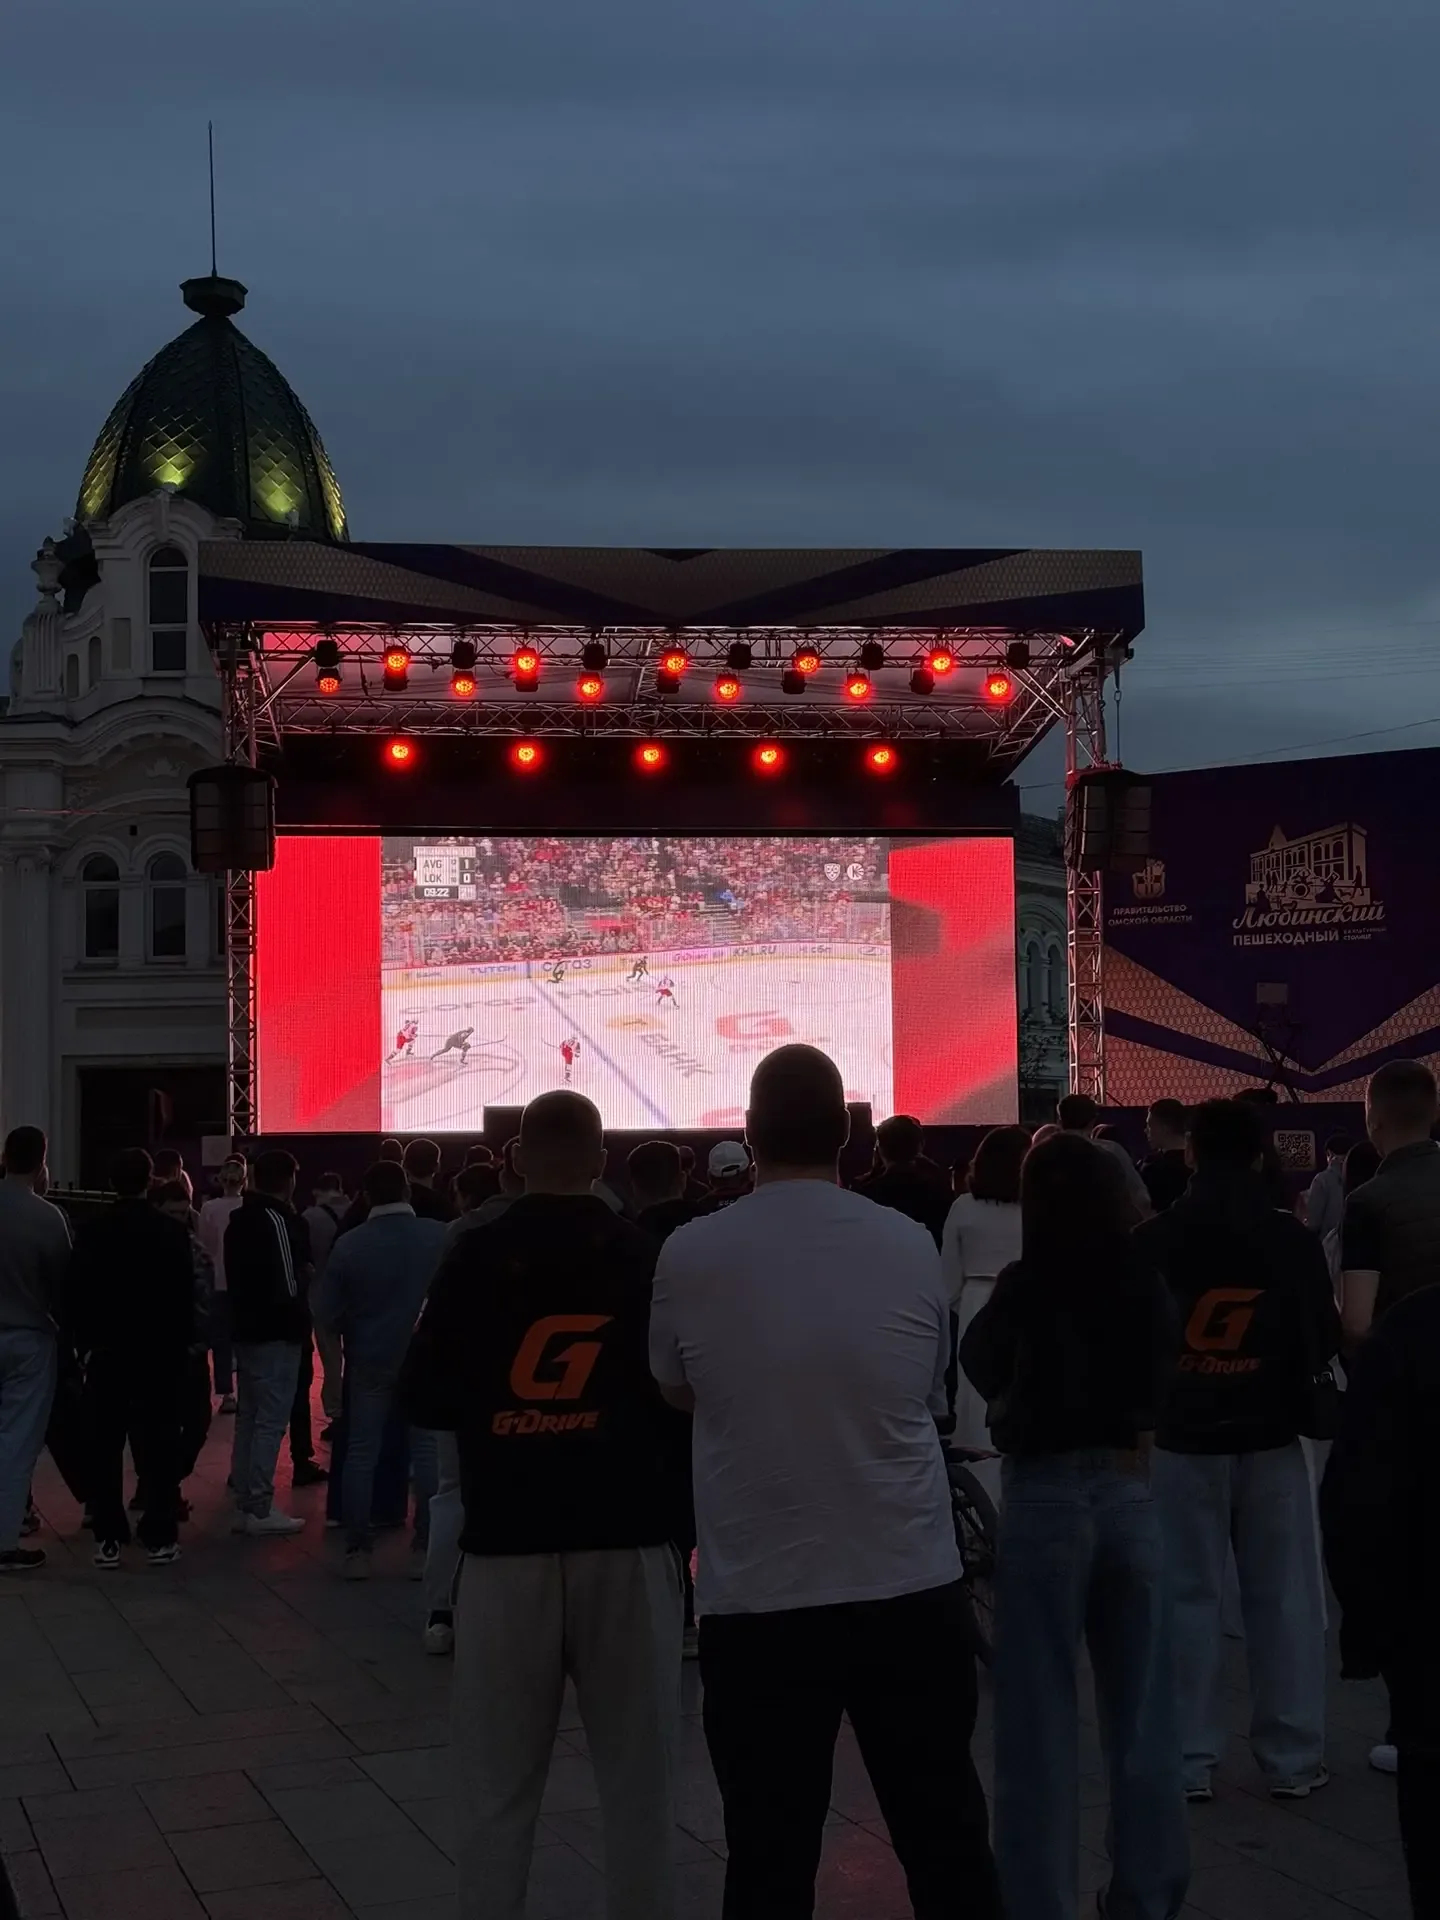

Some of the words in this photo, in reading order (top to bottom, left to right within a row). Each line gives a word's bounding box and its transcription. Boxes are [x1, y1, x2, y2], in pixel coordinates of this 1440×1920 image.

[423, 859, 442, 869] AVG
[463, 858, 470, 870] 1
[424, 874, 442, 883] LOK
[462, 873, 471, 884] 0
[1113, 903, 1188, 916] ПРАВИТЕЛЬСТВО
[1232, 900, 1386, 929] Любинский
[1108, 916, 1149, 926] ОМСКОЙ
[1150, 914, 1194, 925] ОБЛАСТИ
[1233, 929, 1340, 947] ПЕШЕХОДНЫЙ
